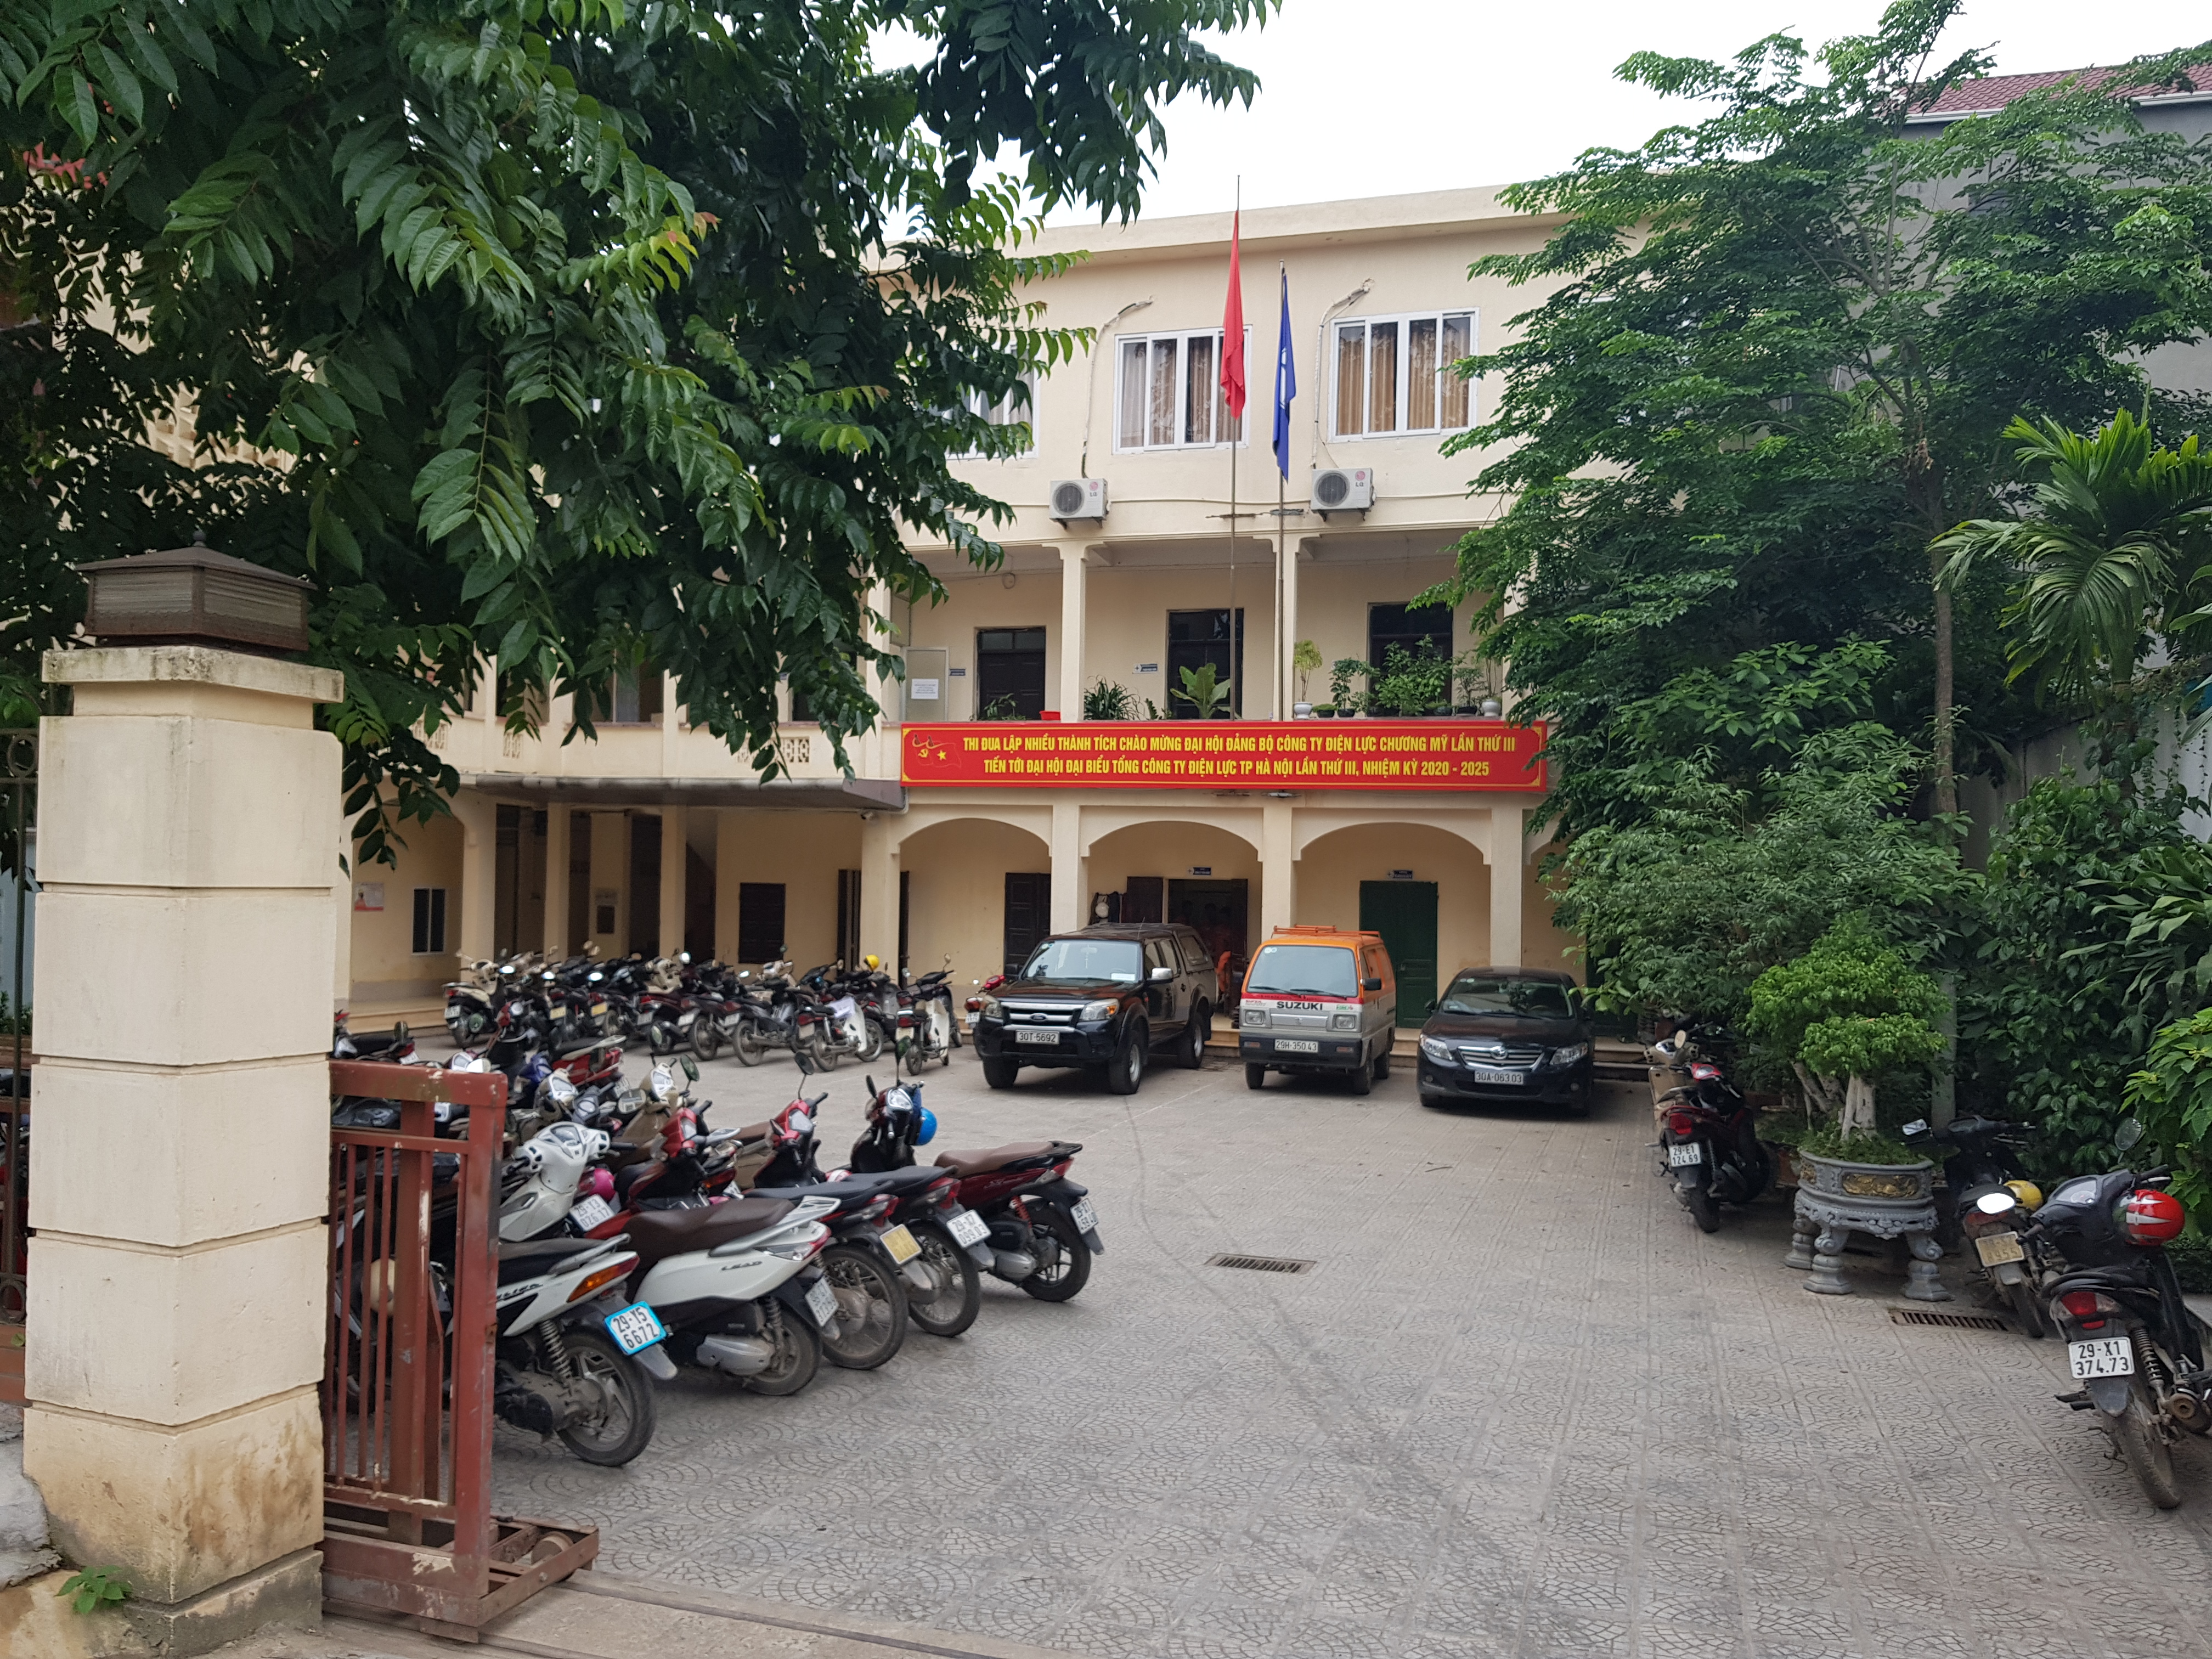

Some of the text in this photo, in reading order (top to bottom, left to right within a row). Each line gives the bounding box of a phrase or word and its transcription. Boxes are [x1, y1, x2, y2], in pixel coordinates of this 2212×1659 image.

[964, 733, 1515, 755] THI ĐUA LẬP NHIỀU THÀNH TÍCH CHÀO MỪNG ĐẠI HỘI ĐẢNG BỘ CÔNG TY ĐIỆN LỰC CHƯƠNG MỸ LẦN THỨ III
[984, 757, 1006, 773] TIẾN
[1009, 757, 1024, 773] TỚI
[1027, 760, 1043, 776] ĐẠI
[1046, 758, 1063, 776] HỘI
[1066, 760, 1083, 776] ĐẠI
[1086, 755, 1109, 774] BIỂU
[1112, 755, 1139, 774] TỔNG
[1142, 758, 1171, 774] CÔNG
[1173, 760, 1186, 774] TY
[1188, 758, 1214, 777] ĐIỆN
[1216, 759, 1237, 778] LỰC
[1240, 761, 1253, 775] TP
[1256, 758, 1271, 775] HÀ
[1274, 759, 1293, 778] NỘI
[1296, 757, 1317, 775] LẦN
[1321, 759, 1342, 775] THỨ
[1345, 761, 1359, 777] III,
[1363, 759, 1400, 778] NHIỆM
[1403, 758, 1418, 776] KỲ
[1421, 761, 1449, 776] 2020
[1461, 762, 1489, 776] 2025
[1277, 1001, 1323, 1011] SUZUKI
[1019, 1032, 1056, 1042] 30T-5692
[613, 1307, 647, 1333] 29-Y5
[623, 1323, 659, 1348] 6672
[2078, 1341, 2120, 1359] 29-X1
[2075, 1357, 2129, 1376] 374.73
